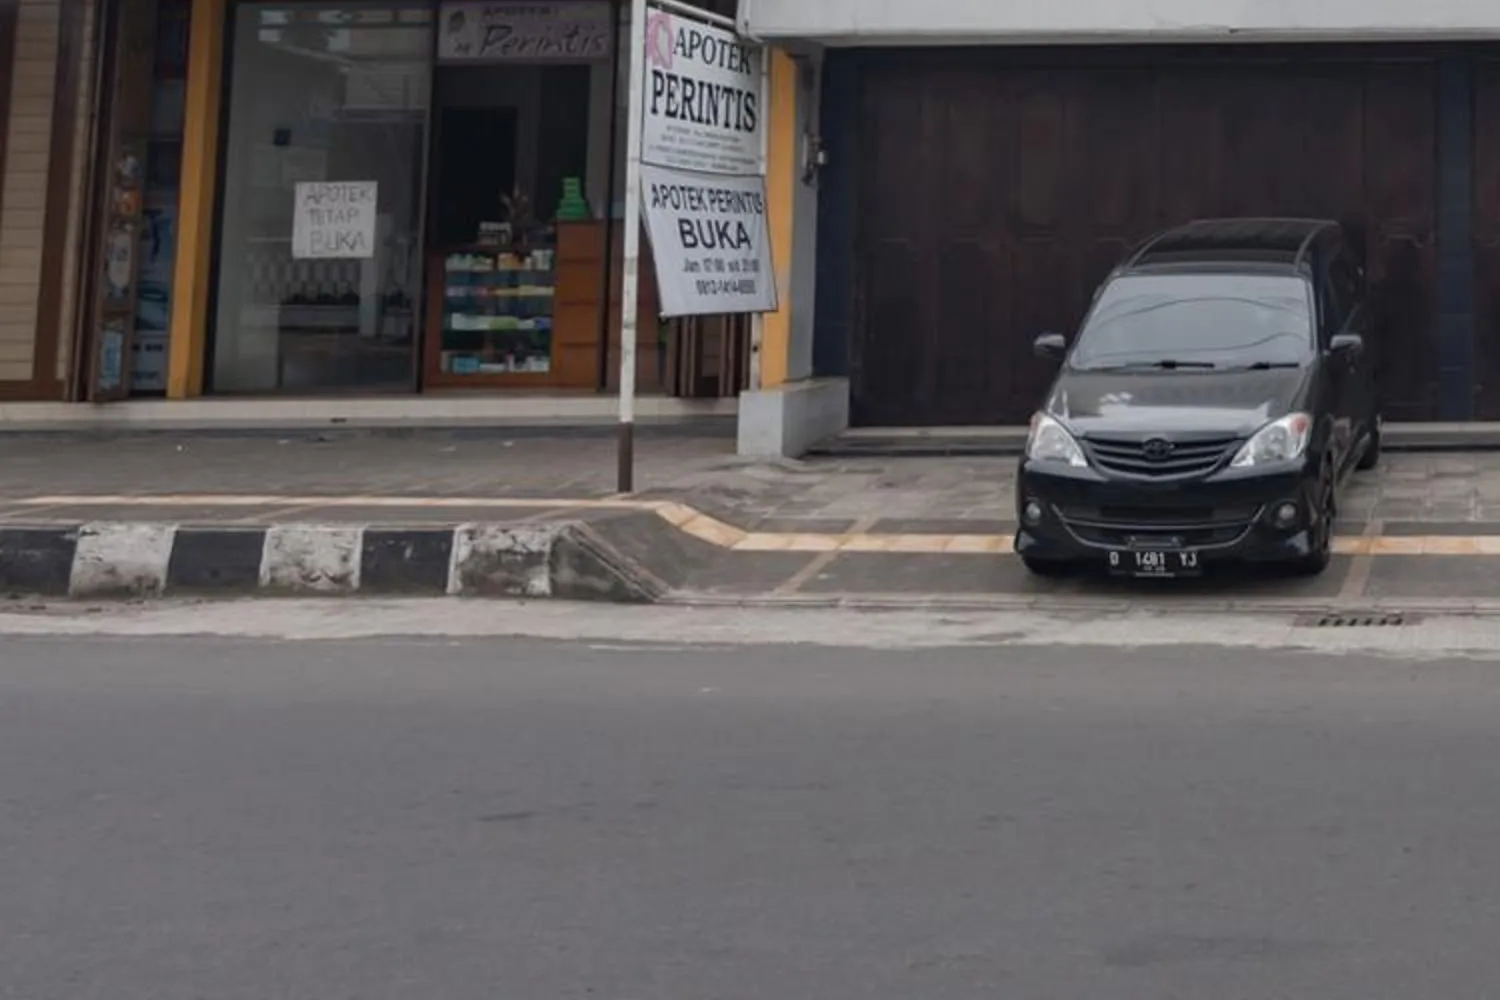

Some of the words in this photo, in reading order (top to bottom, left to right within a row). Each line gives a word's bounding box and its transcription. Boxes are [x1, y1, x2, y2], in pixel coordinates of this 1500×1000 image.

[673, 26, 751, 76] APOTEK
[651, 69, 757, 133] PERINTIS
[651, 183, 707, 213] APOTEK
[677, 217, 753, 250] BUKA
